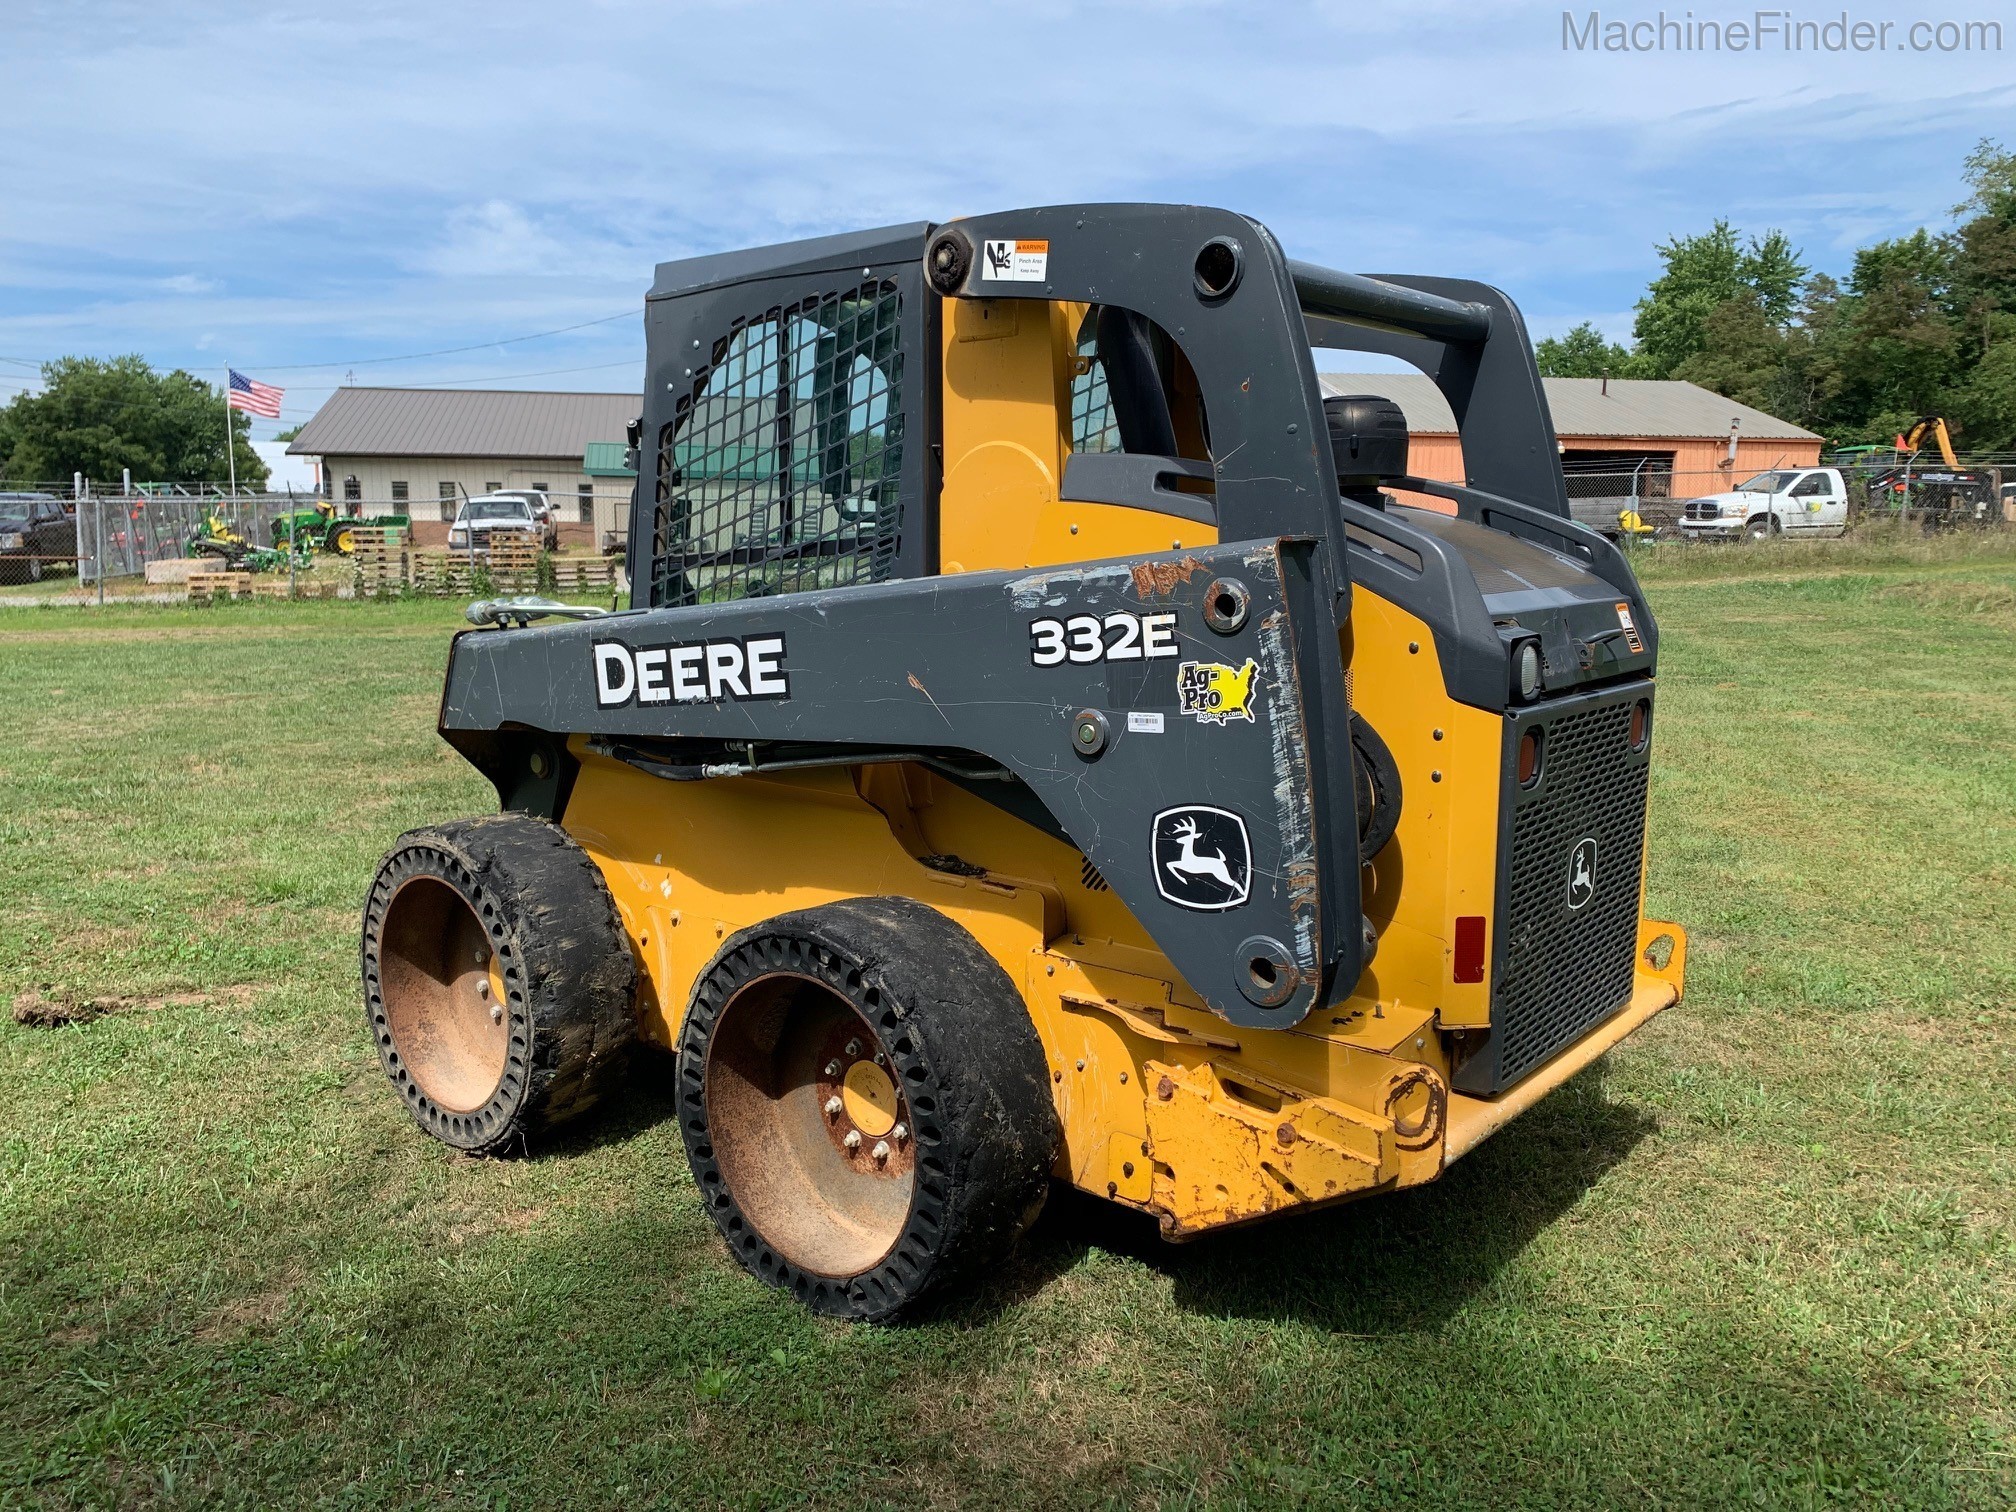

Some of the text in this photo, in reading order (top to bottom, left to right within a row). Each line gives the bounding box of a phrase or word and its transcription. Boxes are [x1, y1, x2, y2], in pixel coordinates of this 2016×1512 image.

[1031, 614, 1178, 664] 332E
[593, 639, 787, 704] DEERE
[1181, 665, 1218, 691] Ag-
[1184, 689, 1221, 710] Pro
[1199, 711, 1243, 721] AgProCo.com
